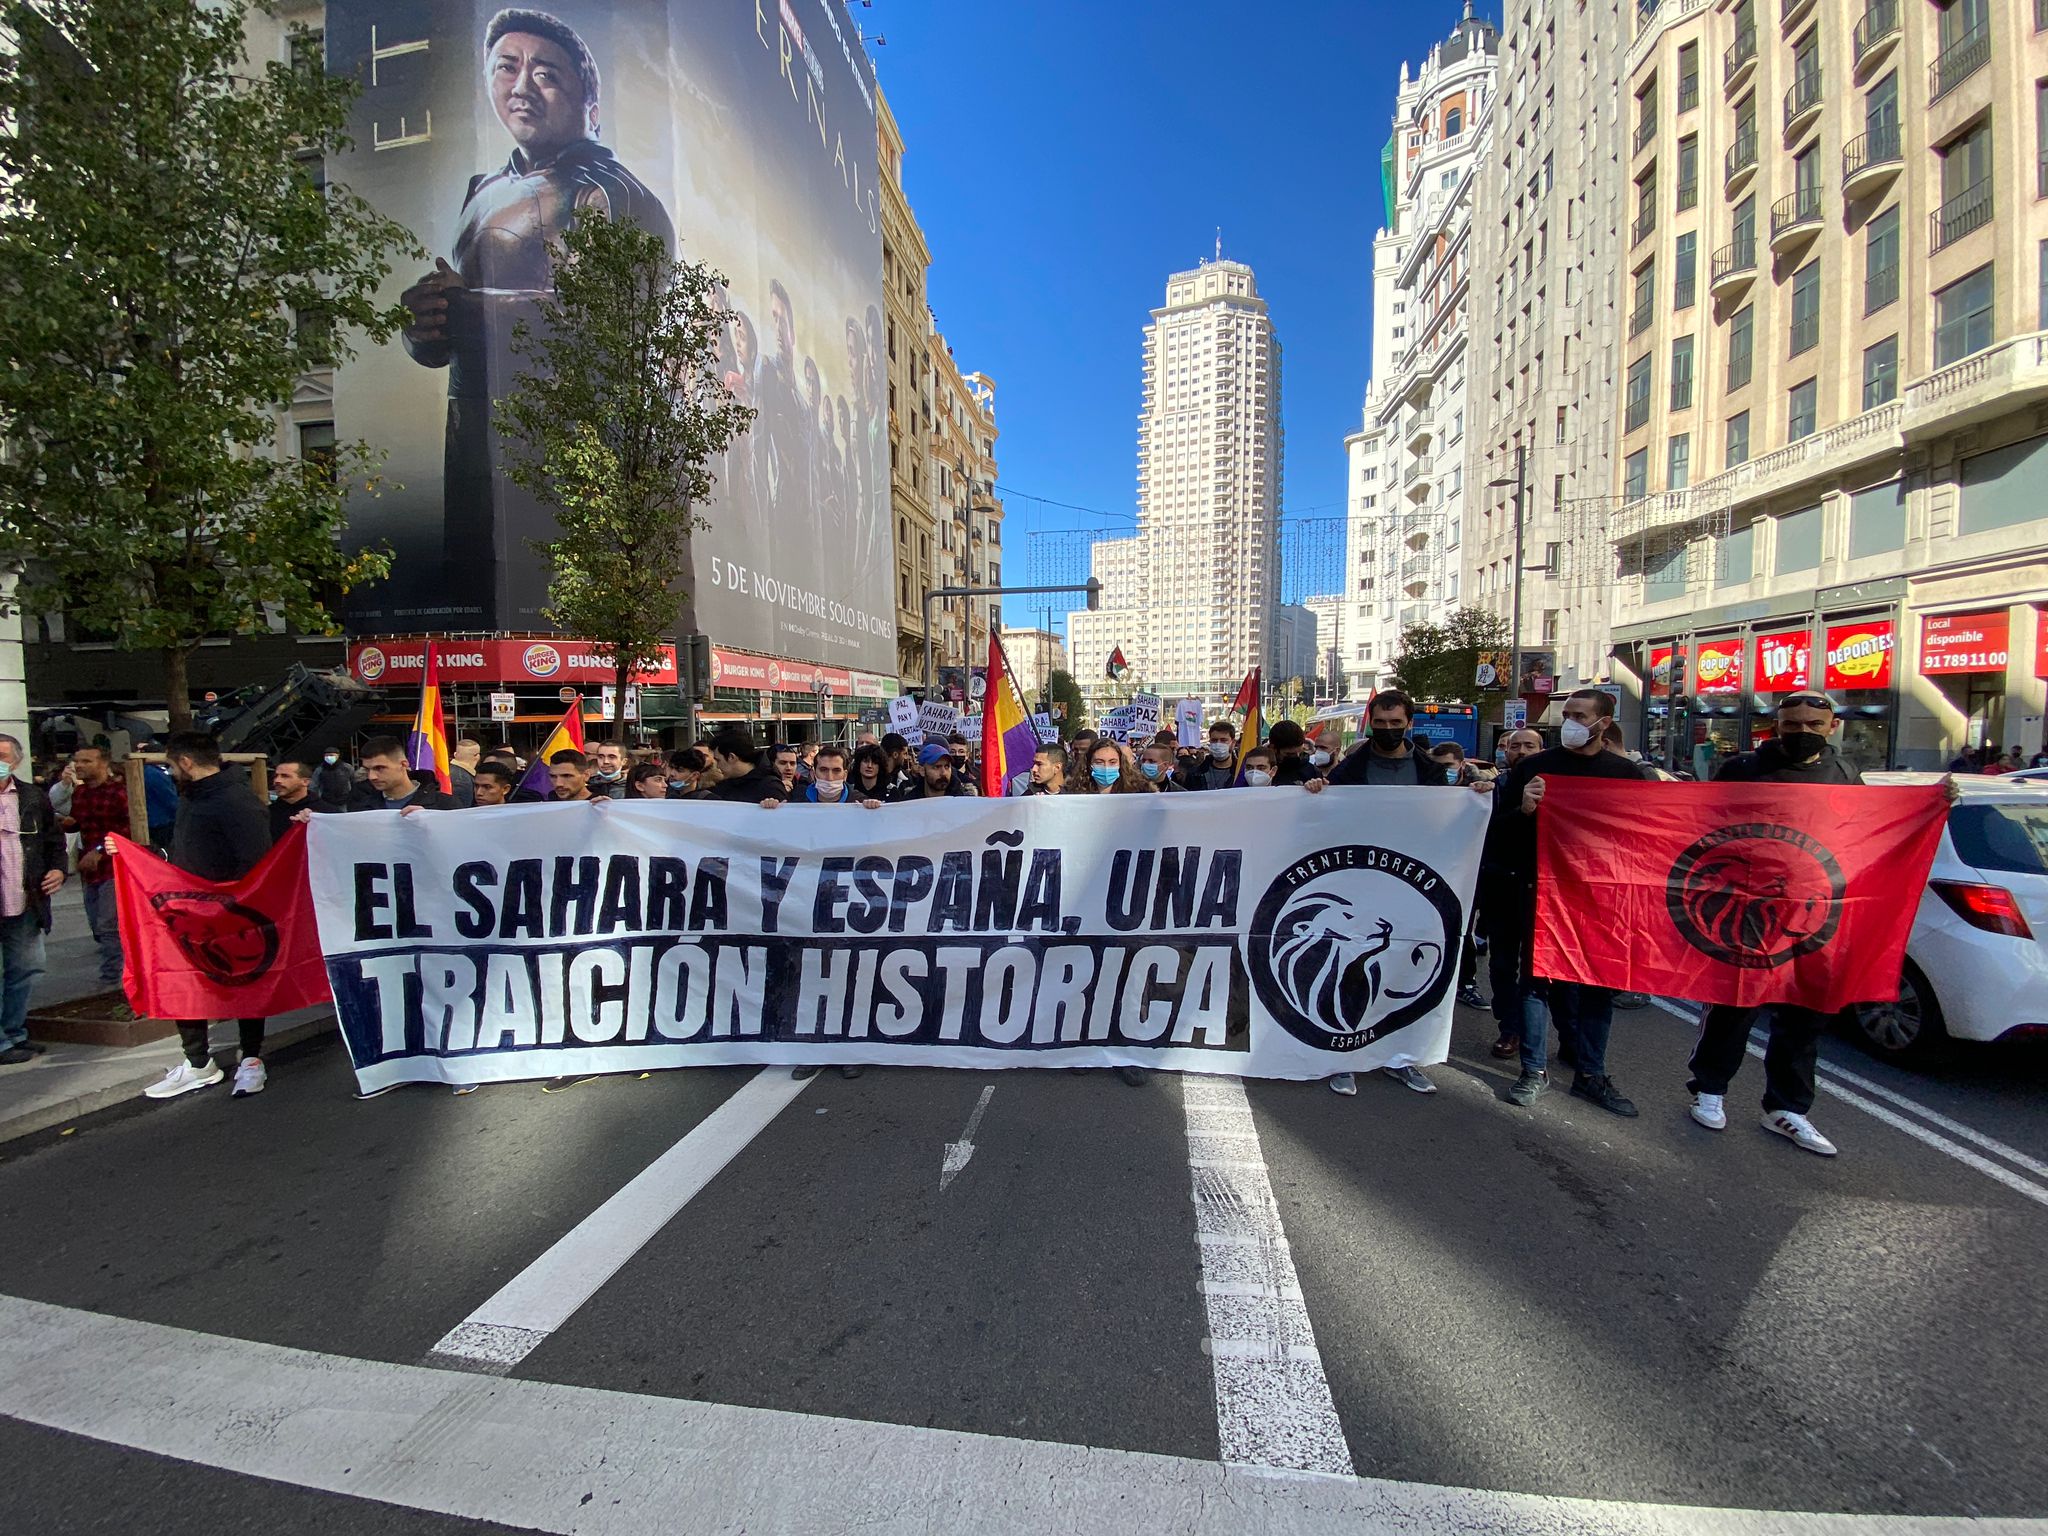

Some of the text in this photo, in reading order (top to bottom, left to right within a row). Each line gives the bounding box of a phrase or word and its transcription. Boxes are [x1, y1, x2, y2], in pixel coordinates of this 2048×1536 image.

[711, 556, 892, 640] 5 DE NOVIEMBRE SOLO EN CINES
[1927, 618, 1951, 630] Local
[1926, 631, 1984, 646] disponible
[527, 650, 555, 662] BURGER
[1827, 632, 1894, 667] DEPORTES
[361, 651, 381, 664] BURGER
[362, 659, 383, 671] KING
[390, 654, 443, 669] BURGR
[529, 657, 556, 670] KING
[1700, 657, 1730, 671] POP UP
[1925, 651, 2007, 668] 91 789 11 00
[723, 664, 749, 676] BURGER
[750, 668, 765, 679] KING
[922, 705, 956, 721] SAHARA:
[1136, 707, 1158, 722] PAZ
[1100, 730, 1127, 743] PAZ
[1286, 850, 1437, 891] FRENTE OBRERO
[353, 829, 1243, 942] EL SAHARA Y ESPAÑA, UNA
[360, 934, 1233, 1056] TRAICIÓN HISTÓRICA
[1330, 1028, 1376, 1048] ESPAÑA
